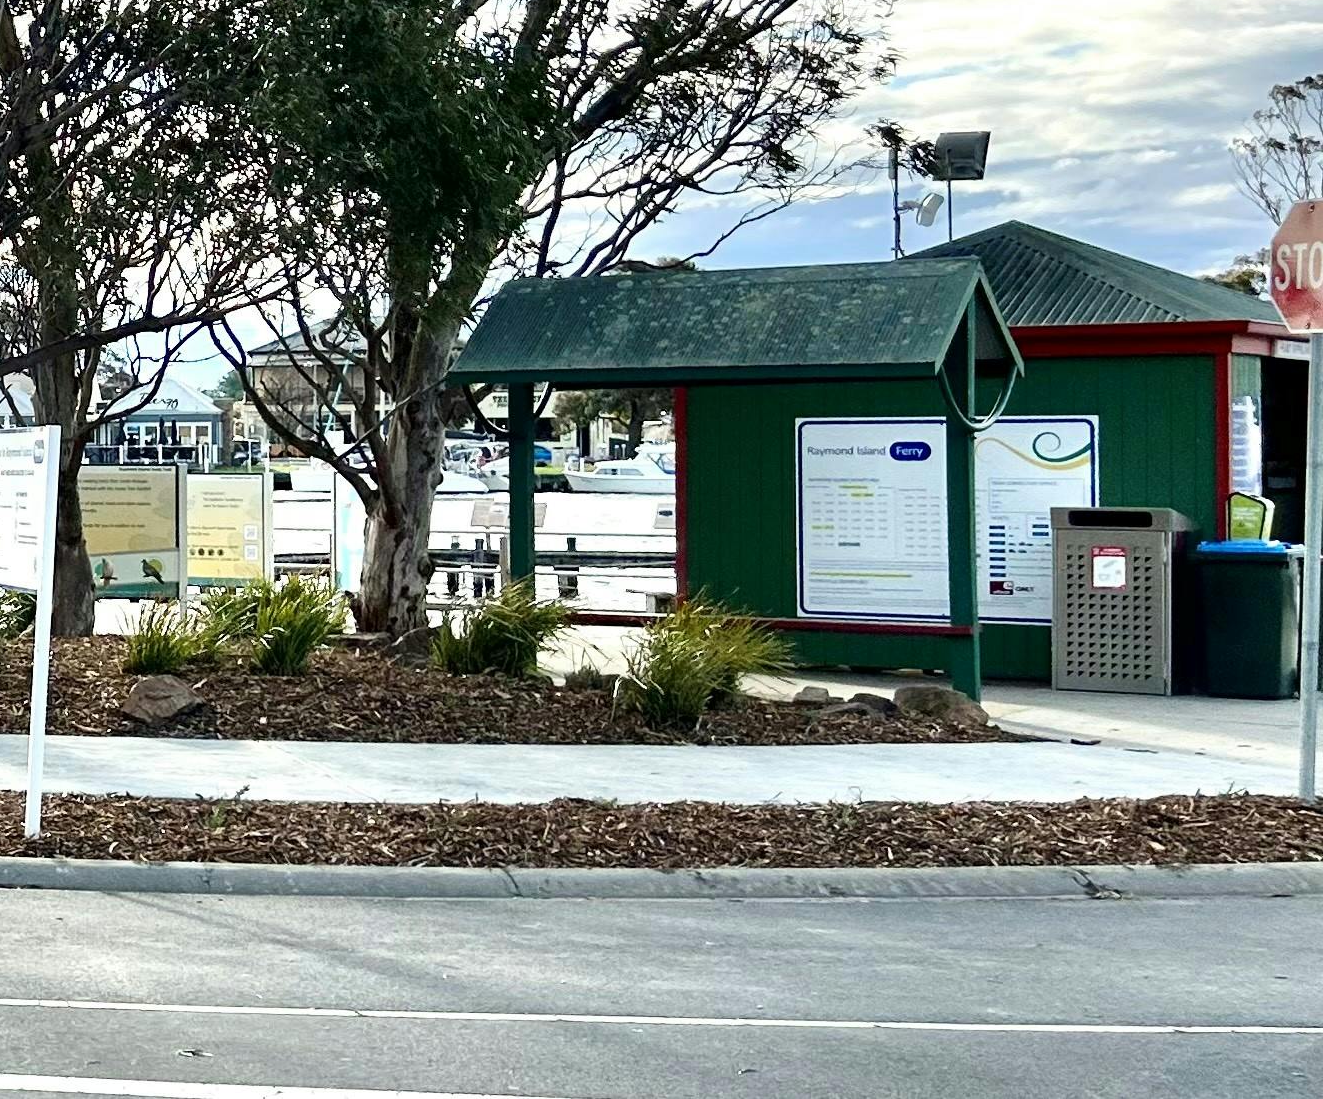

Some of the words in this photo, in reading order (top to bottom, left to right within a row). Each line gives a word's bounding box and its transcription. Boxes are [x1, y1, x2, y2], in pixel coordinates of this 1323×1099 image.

[808, 446, 854, 457] Raymond
[857, 446, 886, 456] Island
[896, 446, 923, 458] Ferry
